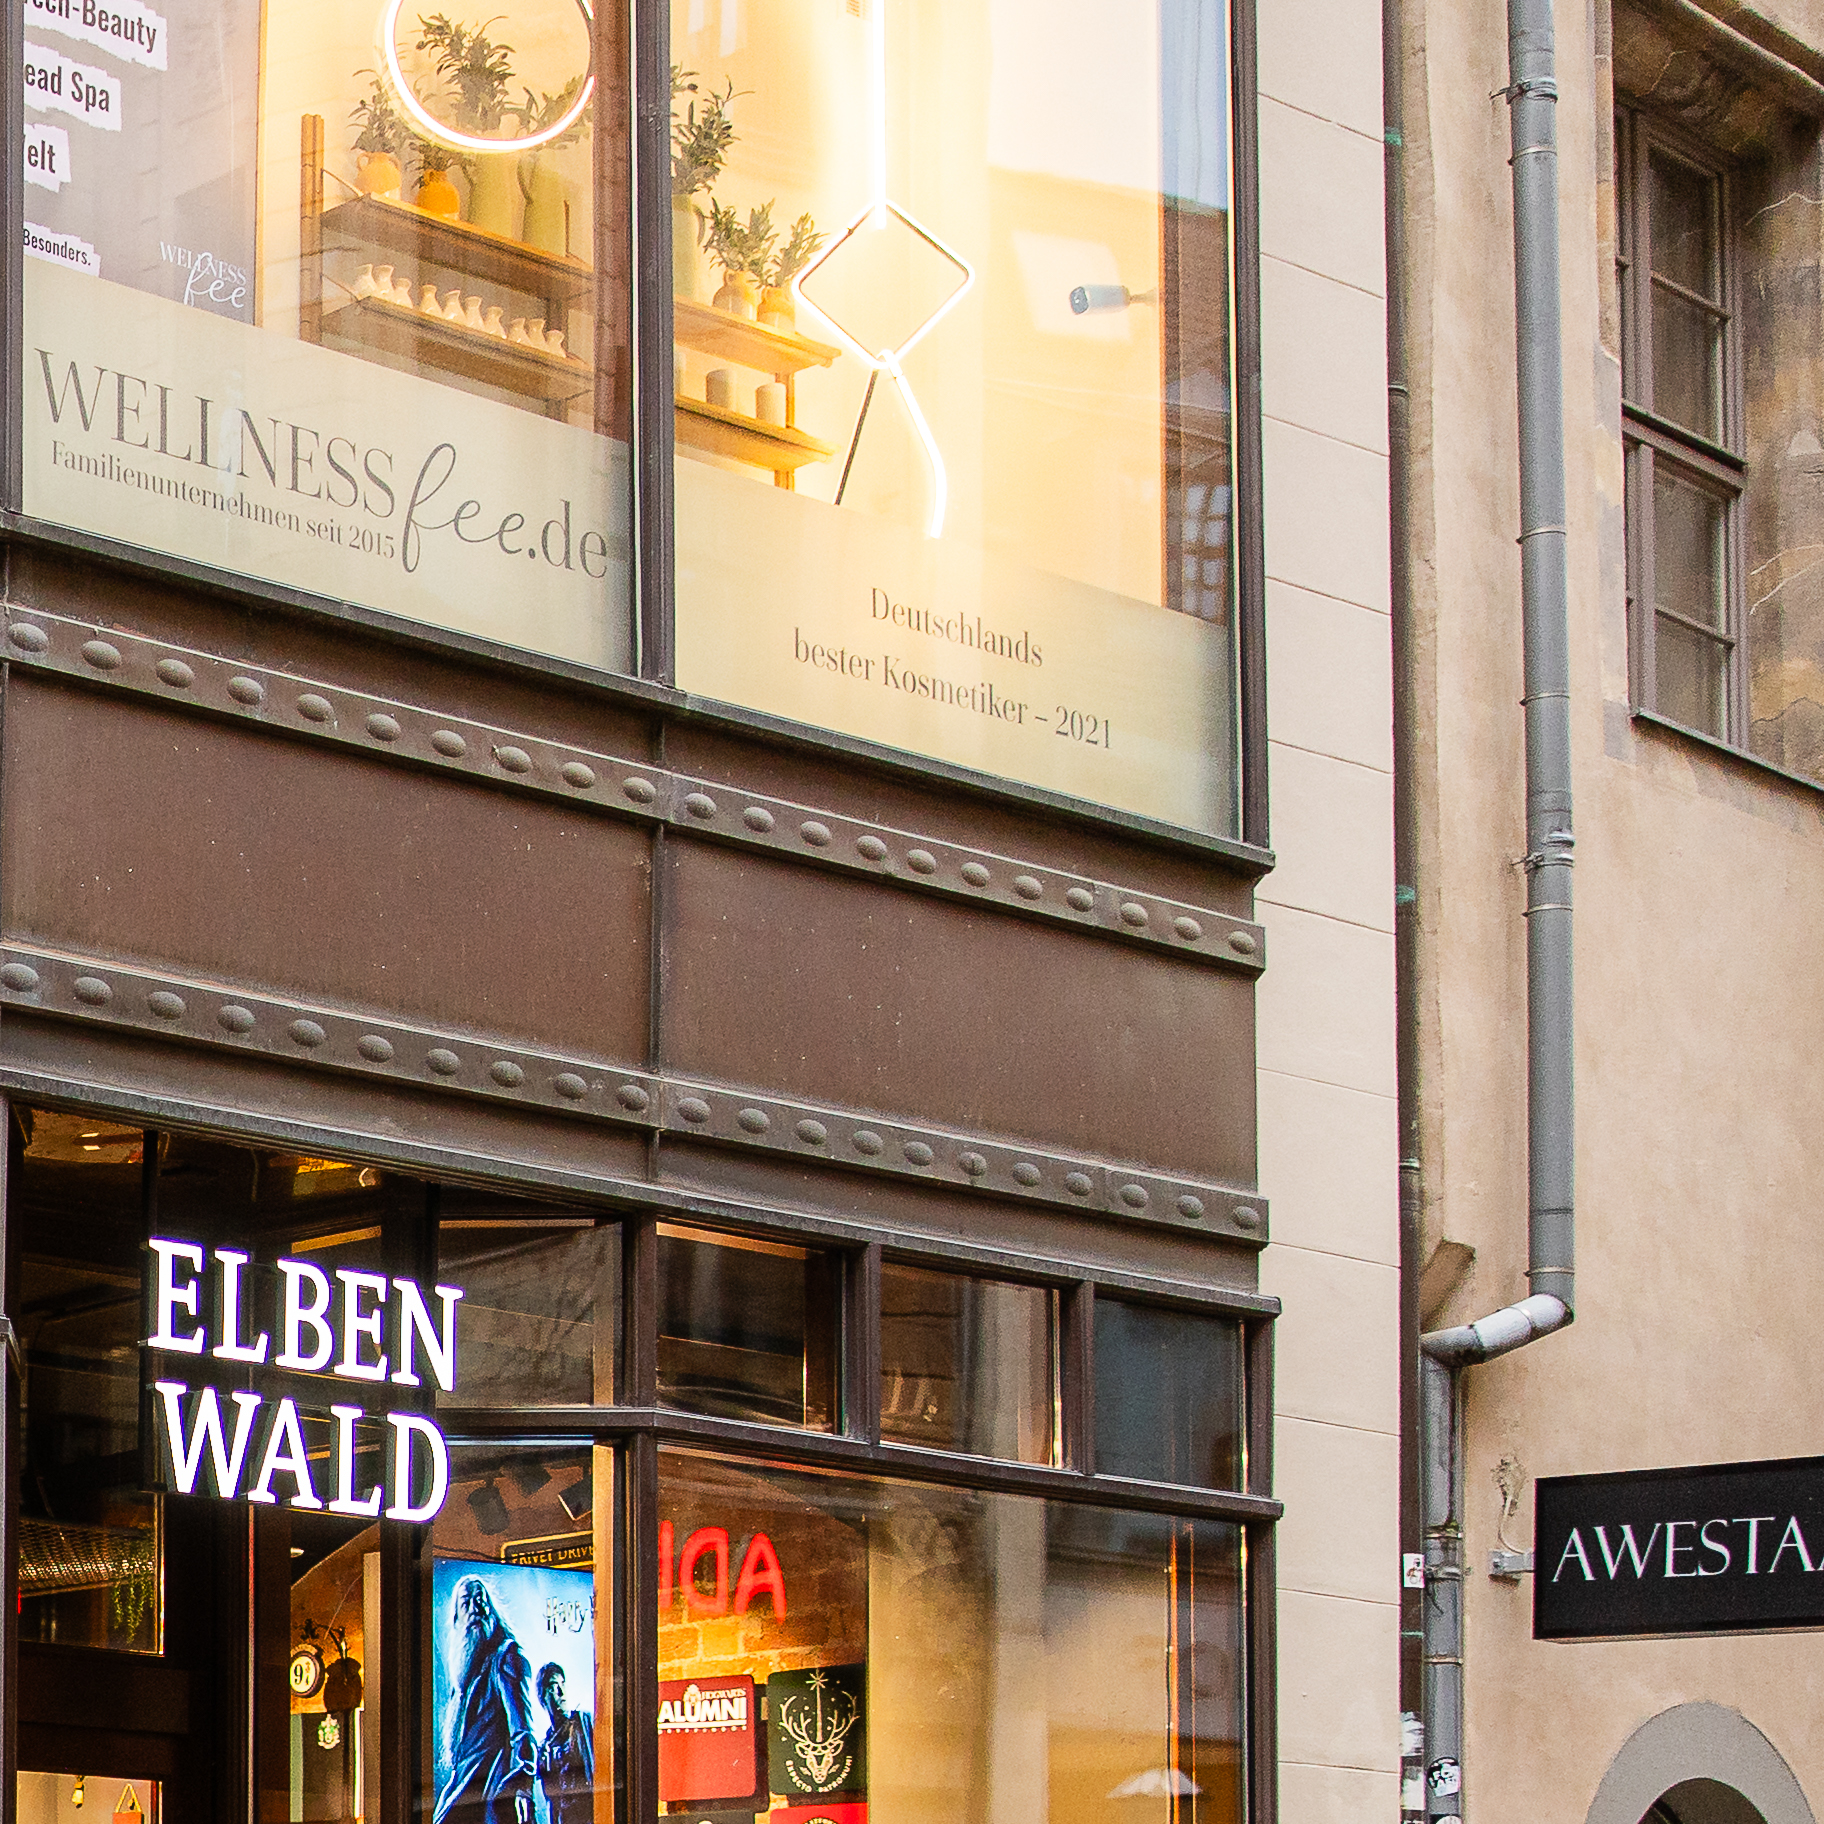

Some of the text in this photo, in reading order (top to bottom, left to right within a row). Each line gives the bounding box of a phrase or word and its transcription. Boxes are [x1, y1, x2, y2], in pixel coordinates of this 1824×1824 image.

[24, 63, 110, 112] ead Spa
[24, 134, 56, 174] elt
[22, 228, 92, 267] Besonders.
[159, 240, 247, 286] WELLNESS
[183, 251, 247, 309] fee
[50, 439, 397, 561] Familienunternehmen seit 2015
[870, 586, 1044, 668] Deutschlands
[793, 626, 876, 682] bester
[883, 654, 1030, 726] Kosmetiker
[1055, 704, 1114, 750] 2021
[147, 1236, 465, 1392] ELBEN
[153, 1379, 451, 1524] WALD
[1551, 1515, 1824, 1583] AWESTA
[542, 1595, 589, 1638] Harry
[658, 1697, 748, 1723] ALUMNI
